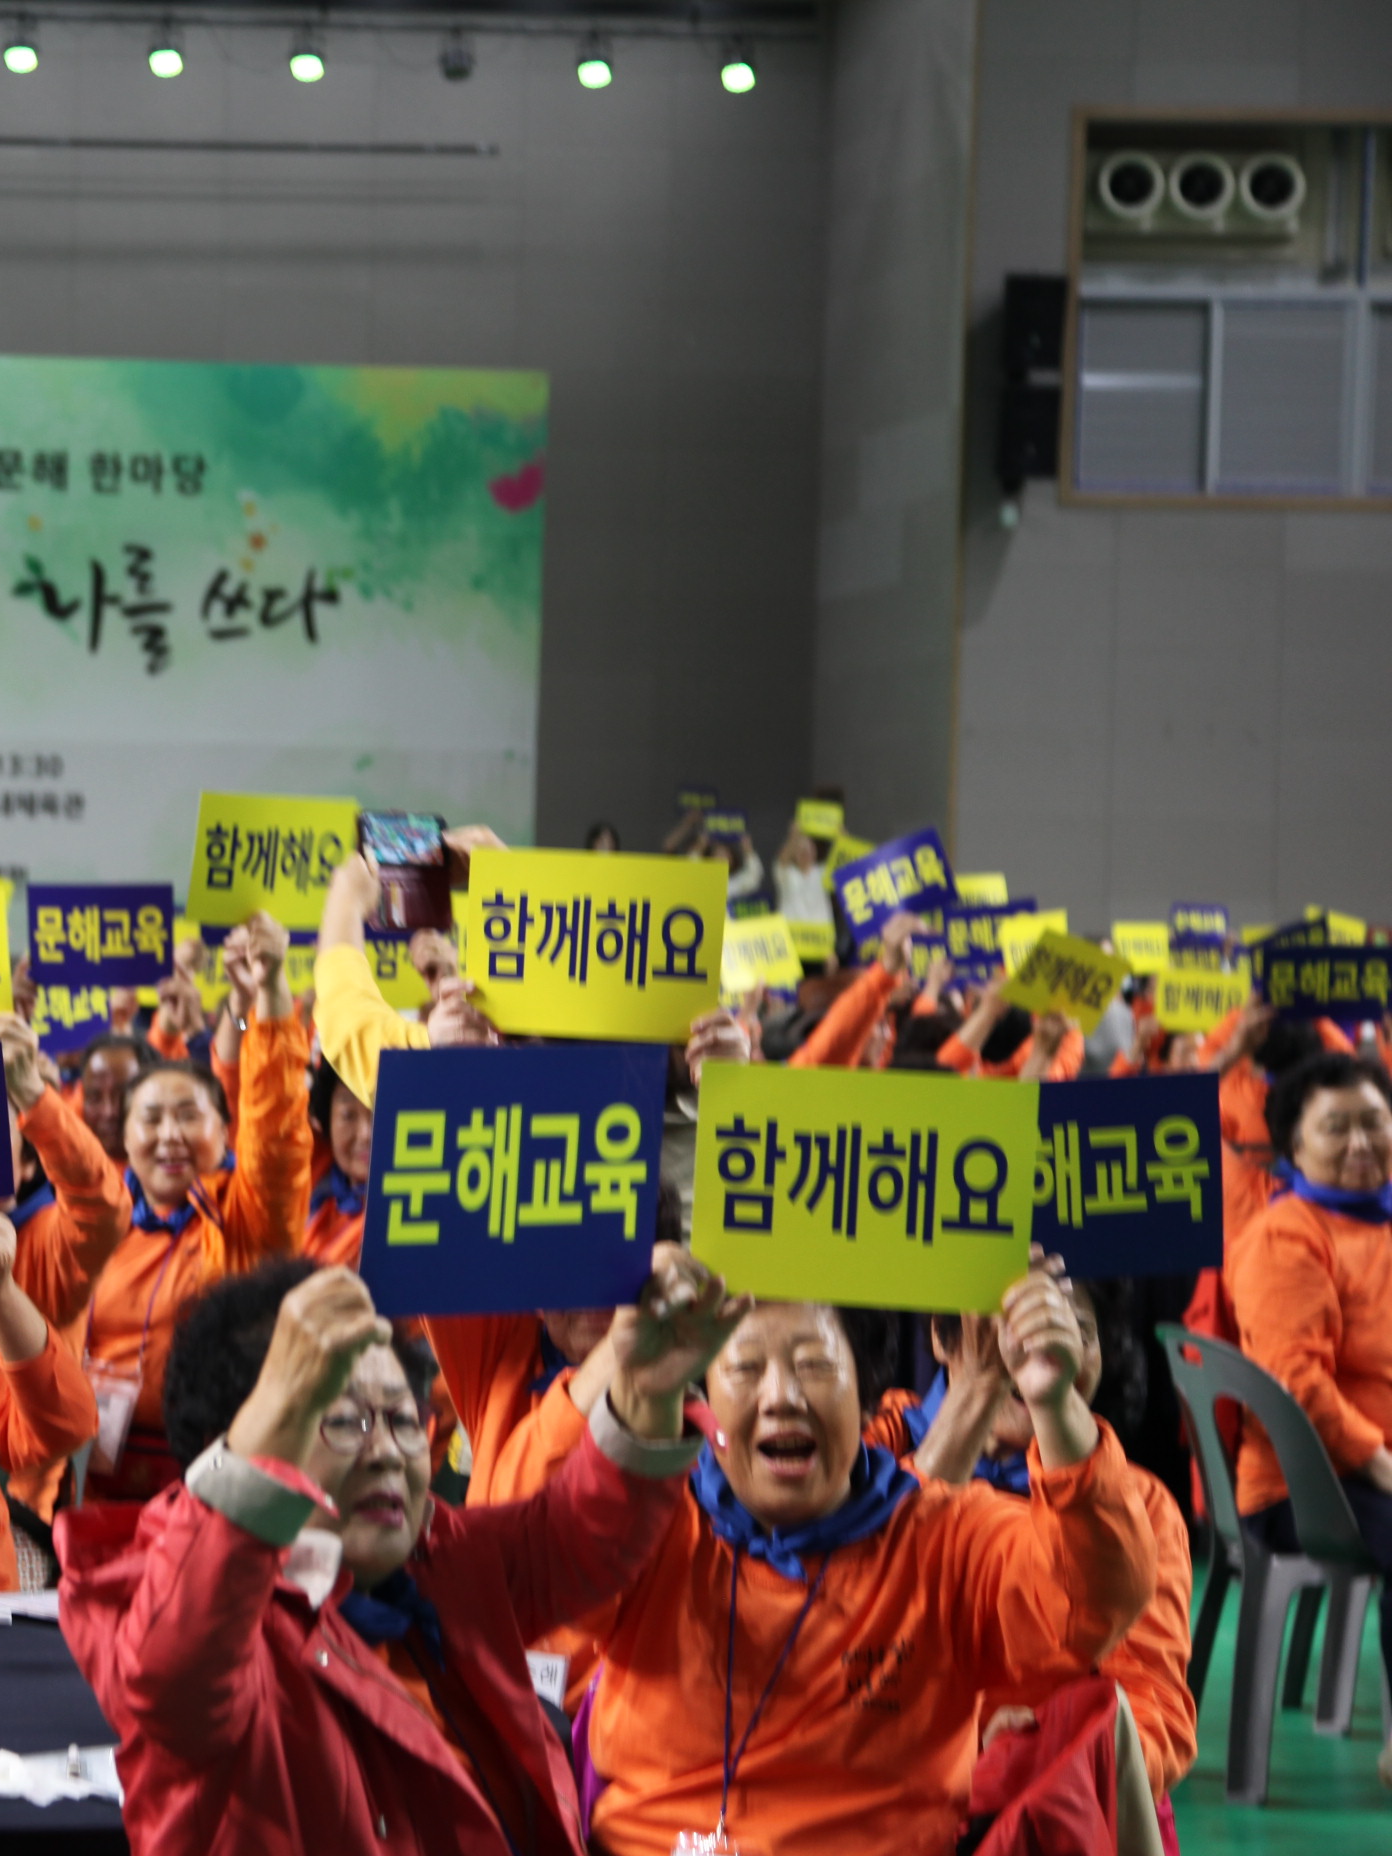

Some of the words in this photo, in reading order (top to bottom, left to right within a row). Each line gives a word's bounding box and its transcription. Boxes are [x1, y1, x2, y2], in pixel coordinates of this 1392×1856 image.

[88, 450, 208, 497] 한마당
[20, 542, 174, 675] 나를
[200, 556, 340, 645] 쓰다
[206, 822, 344, 893] 함께해요
[35, 905, 169, 965] 문해교육
[481, 888, 708, 993] 함께해요
[382, 1102, 647, 1246] 문해교육
[715, 1112, 1014, 1248] 함께해요
